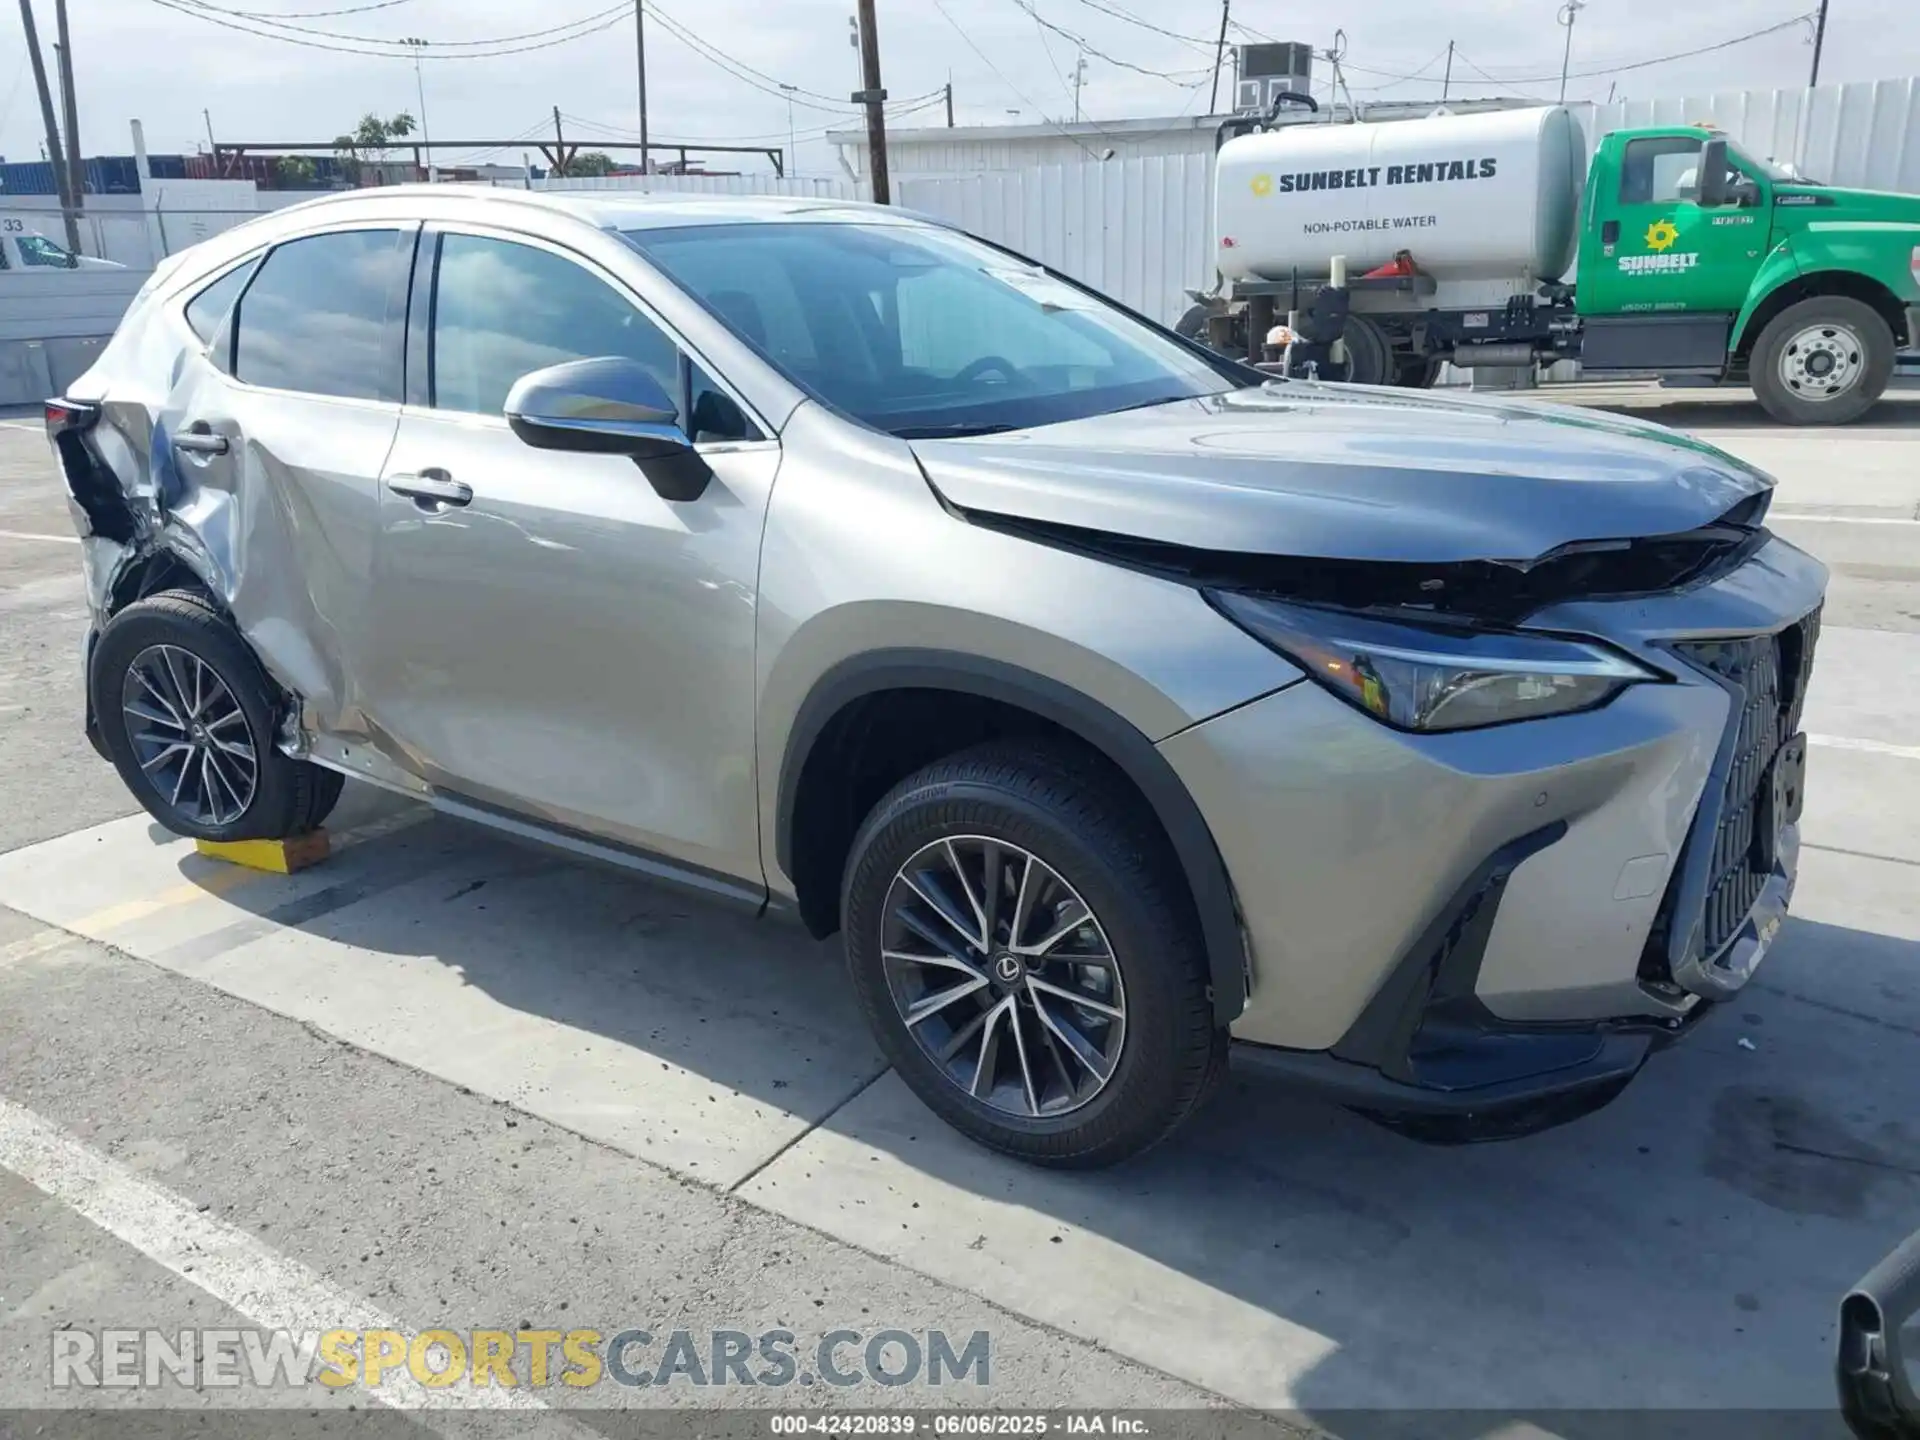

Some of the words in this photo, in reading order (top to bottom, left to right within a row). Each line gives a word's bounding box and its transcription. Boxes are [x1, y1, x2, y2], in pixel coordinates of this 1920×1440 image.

[1279, 167, 1380, 193] SUNBELT
[1386, 157, 1497, 185] RENTALS
[3, 218, 24, 232] 33
[1303, 218, 1390, 234] NON-POTABLE
[1393, 215, 1437, 229] WATER
[1618, 252, 1699, 271] SUNBELT
